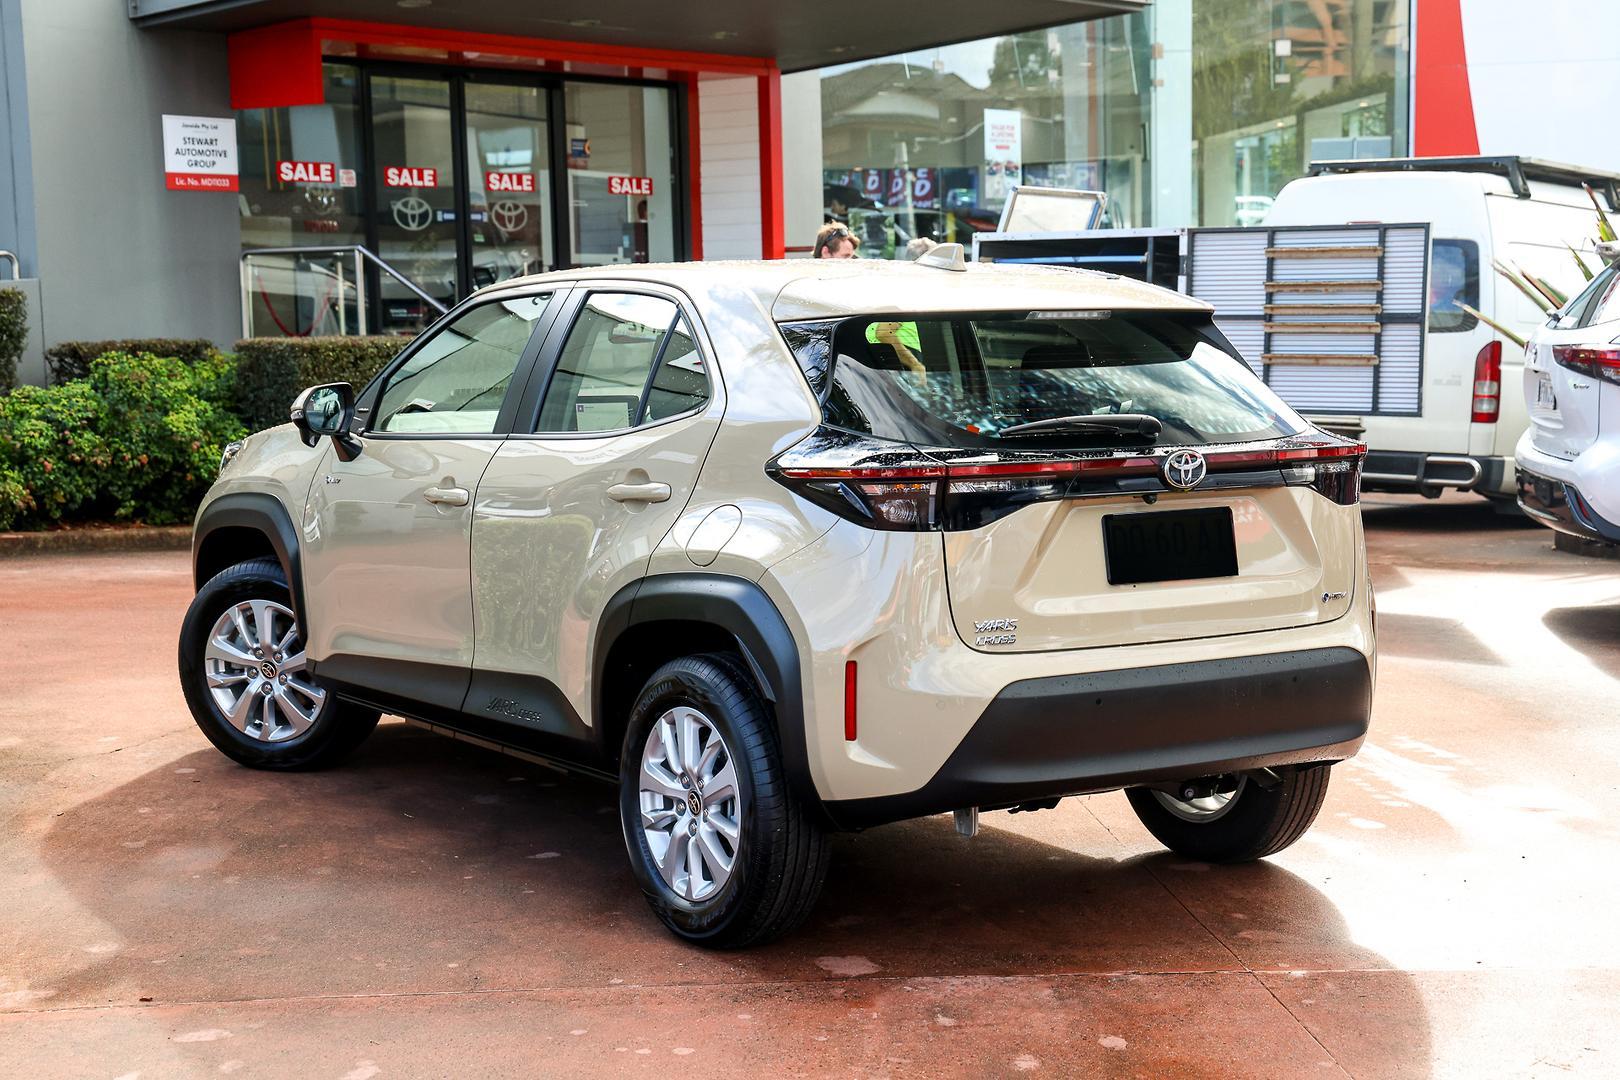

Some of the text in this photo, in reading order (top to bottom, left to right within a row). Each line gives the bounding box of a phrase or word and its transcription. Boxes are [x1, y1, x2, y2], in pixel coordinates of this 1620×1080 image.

[182, 136, 218, 146] STEWART
[175, 147, 228, 158] AUTOMOTIVE
[187, 159, 217, 168] GROUP
[280, 161, 333, 182] SALE
[387, 168, 435, 187] SALE
[175, 177, 187, 186] Lic.
[187, 177, 200, 186] No.
[488, 173, 533, 191] SALE
[611, 177, 651, 194] SALE
[974, 618, 1019, 633] YARIS
[975, 634, 1017, 646] CROSS
